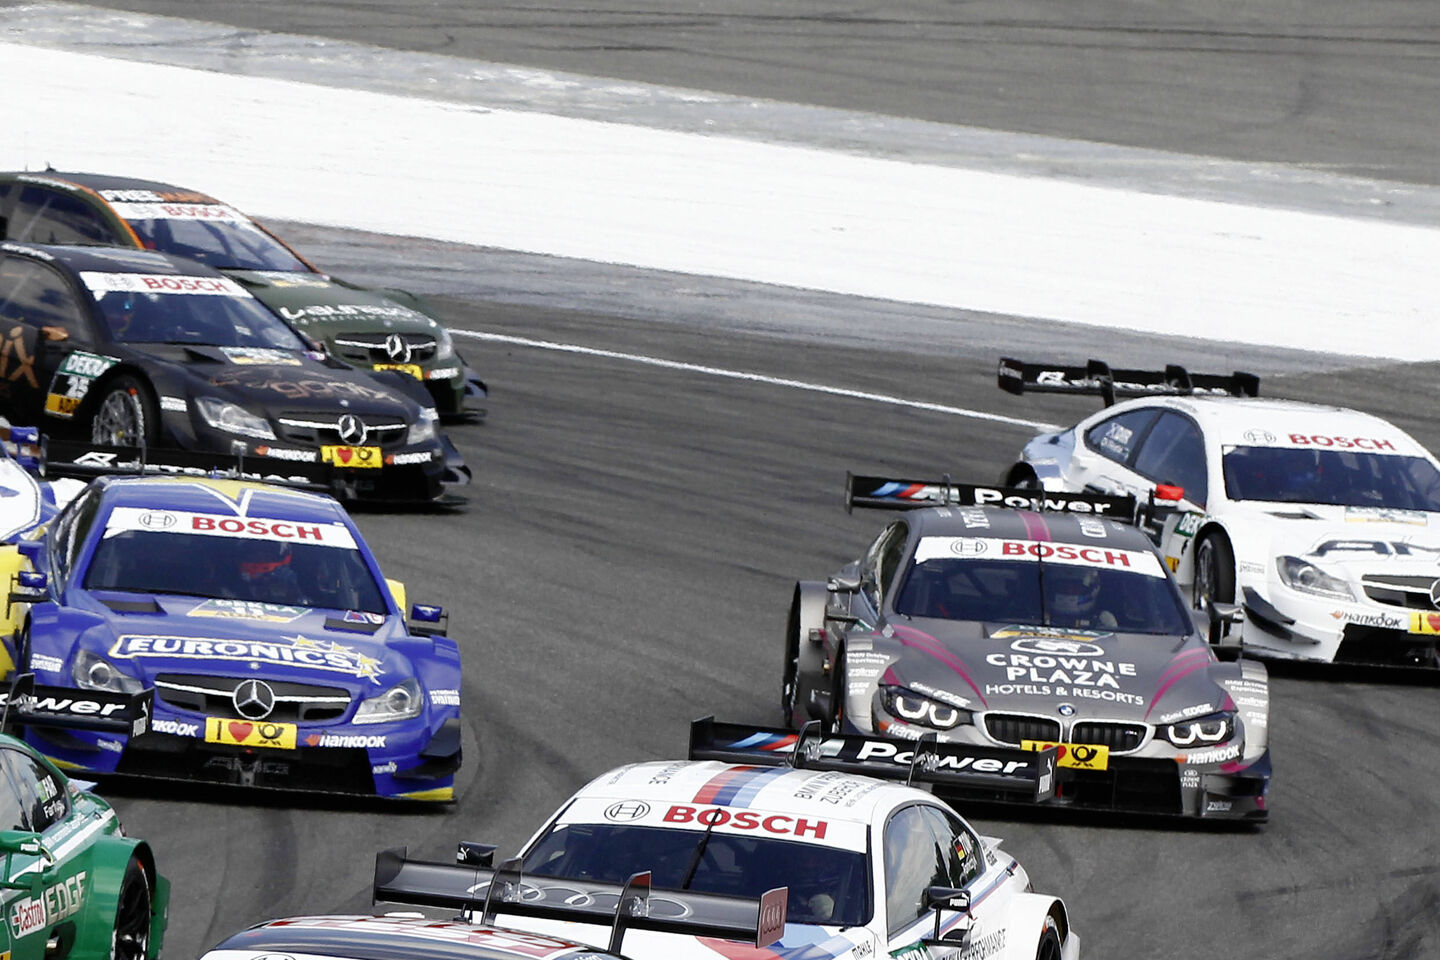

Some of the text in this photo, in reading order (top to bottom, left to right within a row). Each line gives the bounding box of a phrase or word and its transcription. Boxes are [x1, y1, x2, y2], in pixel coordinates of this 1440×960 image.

[142, 277, 233, 293] BOSCH
[66, 376, 91, 399] 25
[1288, 433, 1397, 452] BOSCH
[973, 487, 1112, 515] Power
[191, 515, 324, 541] BOSCH
[1002, 541, 1131, 568] BOSCH
[128, 637, 354, 669] EURONICS
[986, 653, 1137, 677] CROWNE
[1006, 666, 1121, 689] PLAZA
[985, 684, 1051, 697] HOTELS
[1055, 686, 1069, 697] &
[1072, 687, 1145, 706] RESORTS
[662, 805, 828, 840] BOSCH
[19, 870, 87, 932] Castrol EDGE
